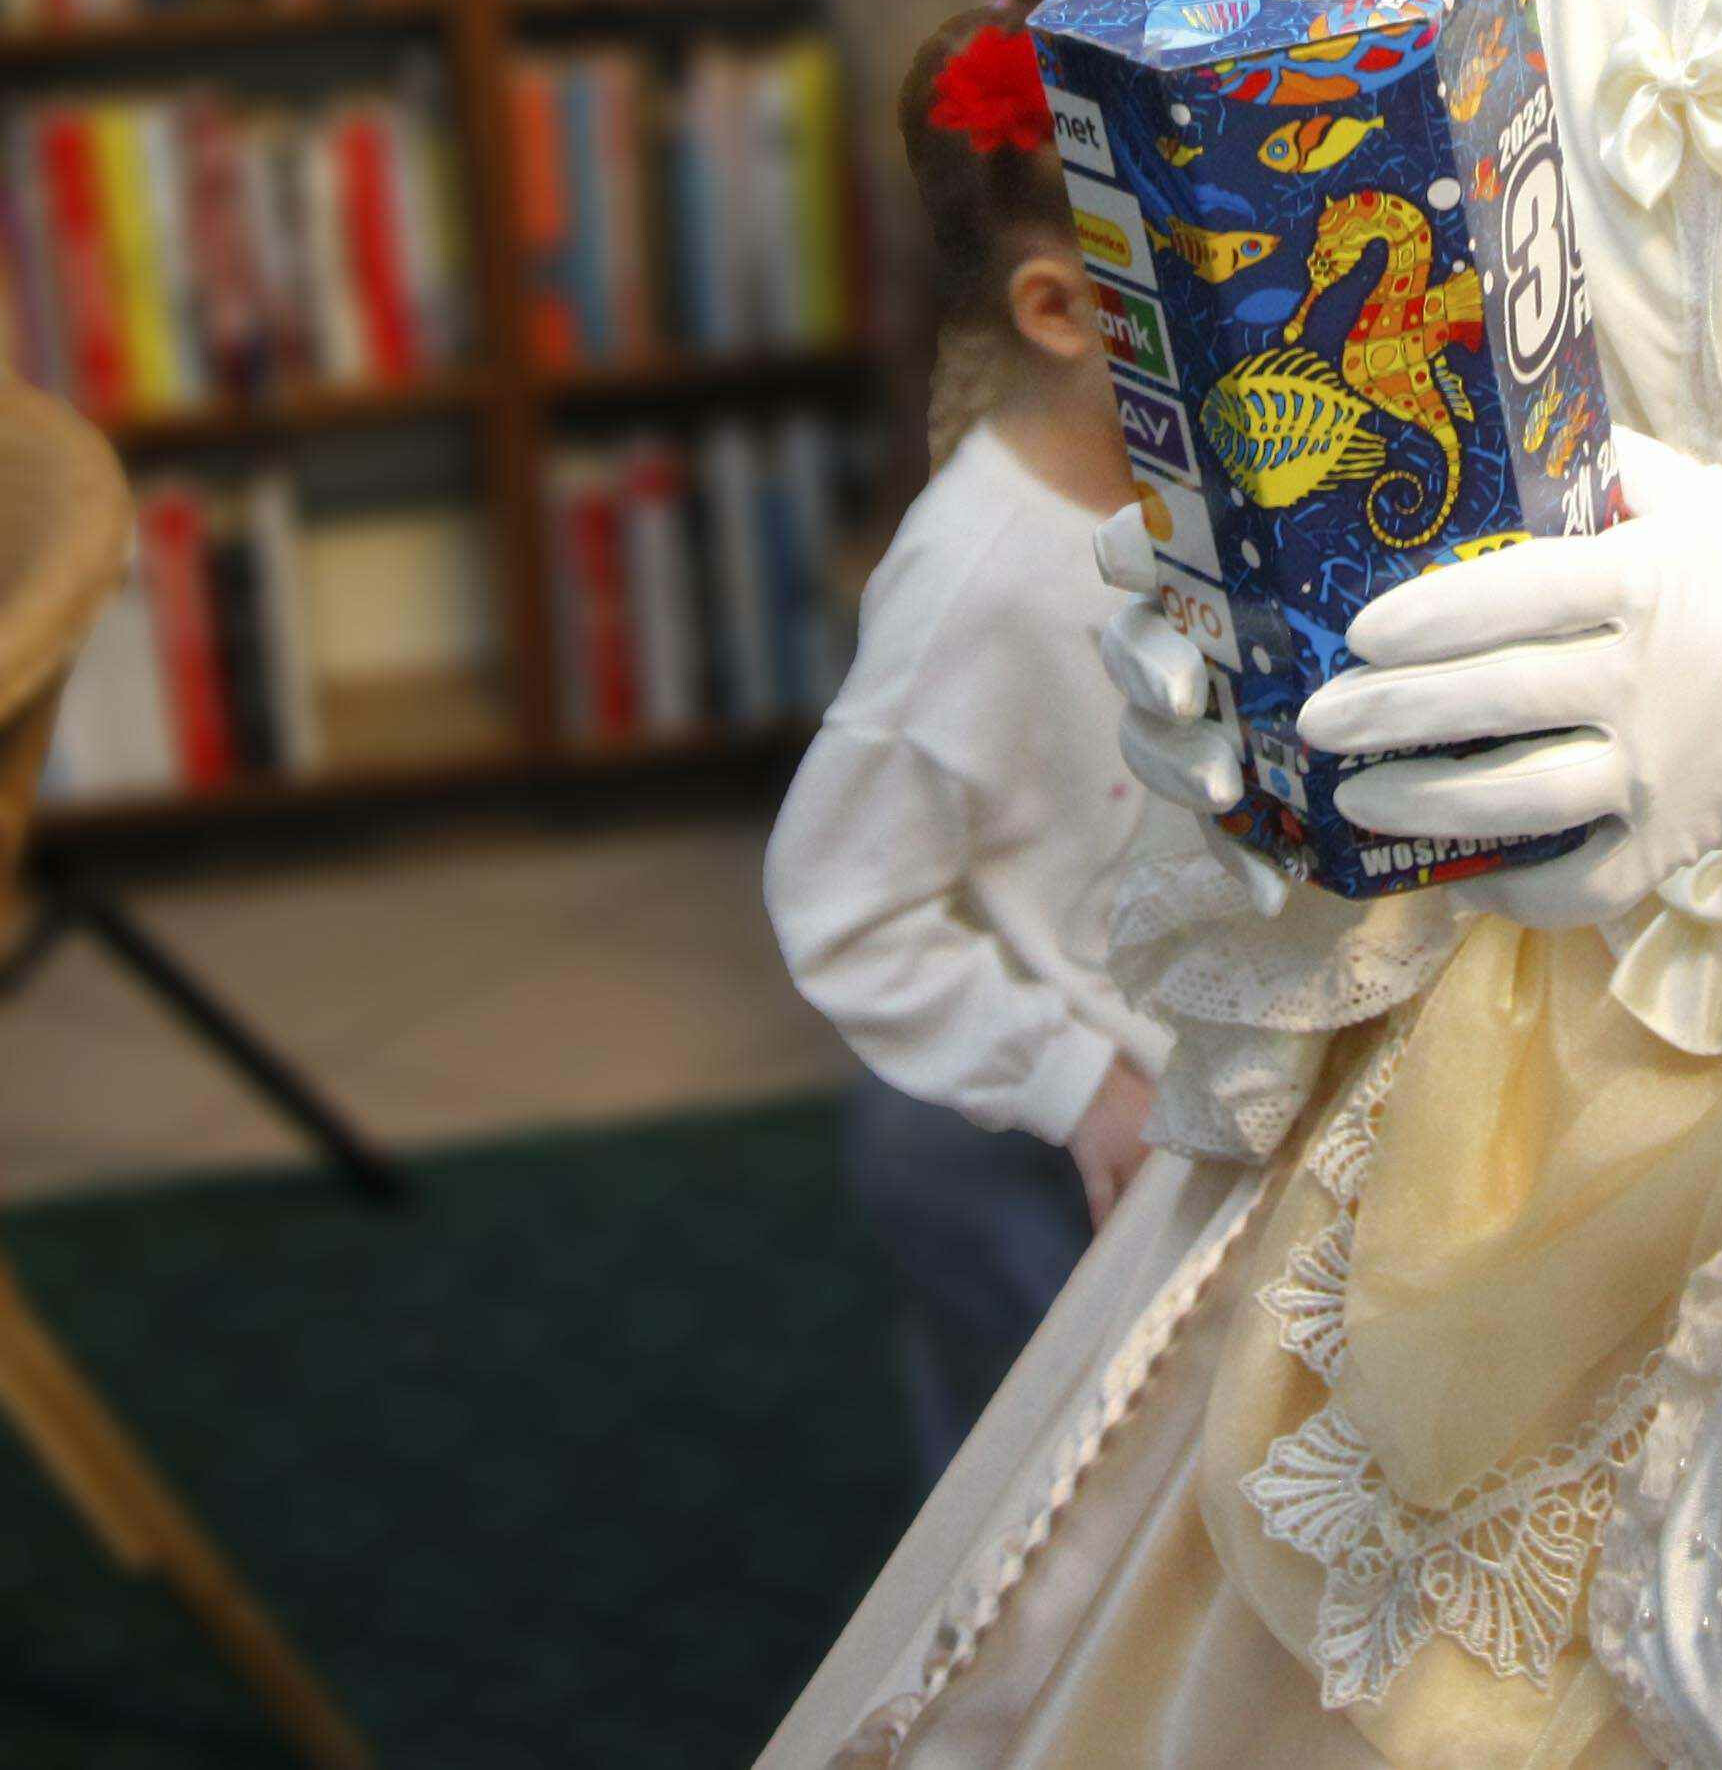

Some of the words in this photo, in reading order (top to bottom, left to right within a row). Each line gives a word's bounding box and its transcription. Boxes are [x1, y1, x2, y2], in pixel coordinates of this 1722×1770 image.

[1055, 111, 1100, 151] net
[1498, 84, 1548, 173] 2023
[1160, 585, 1222, 639] gro
